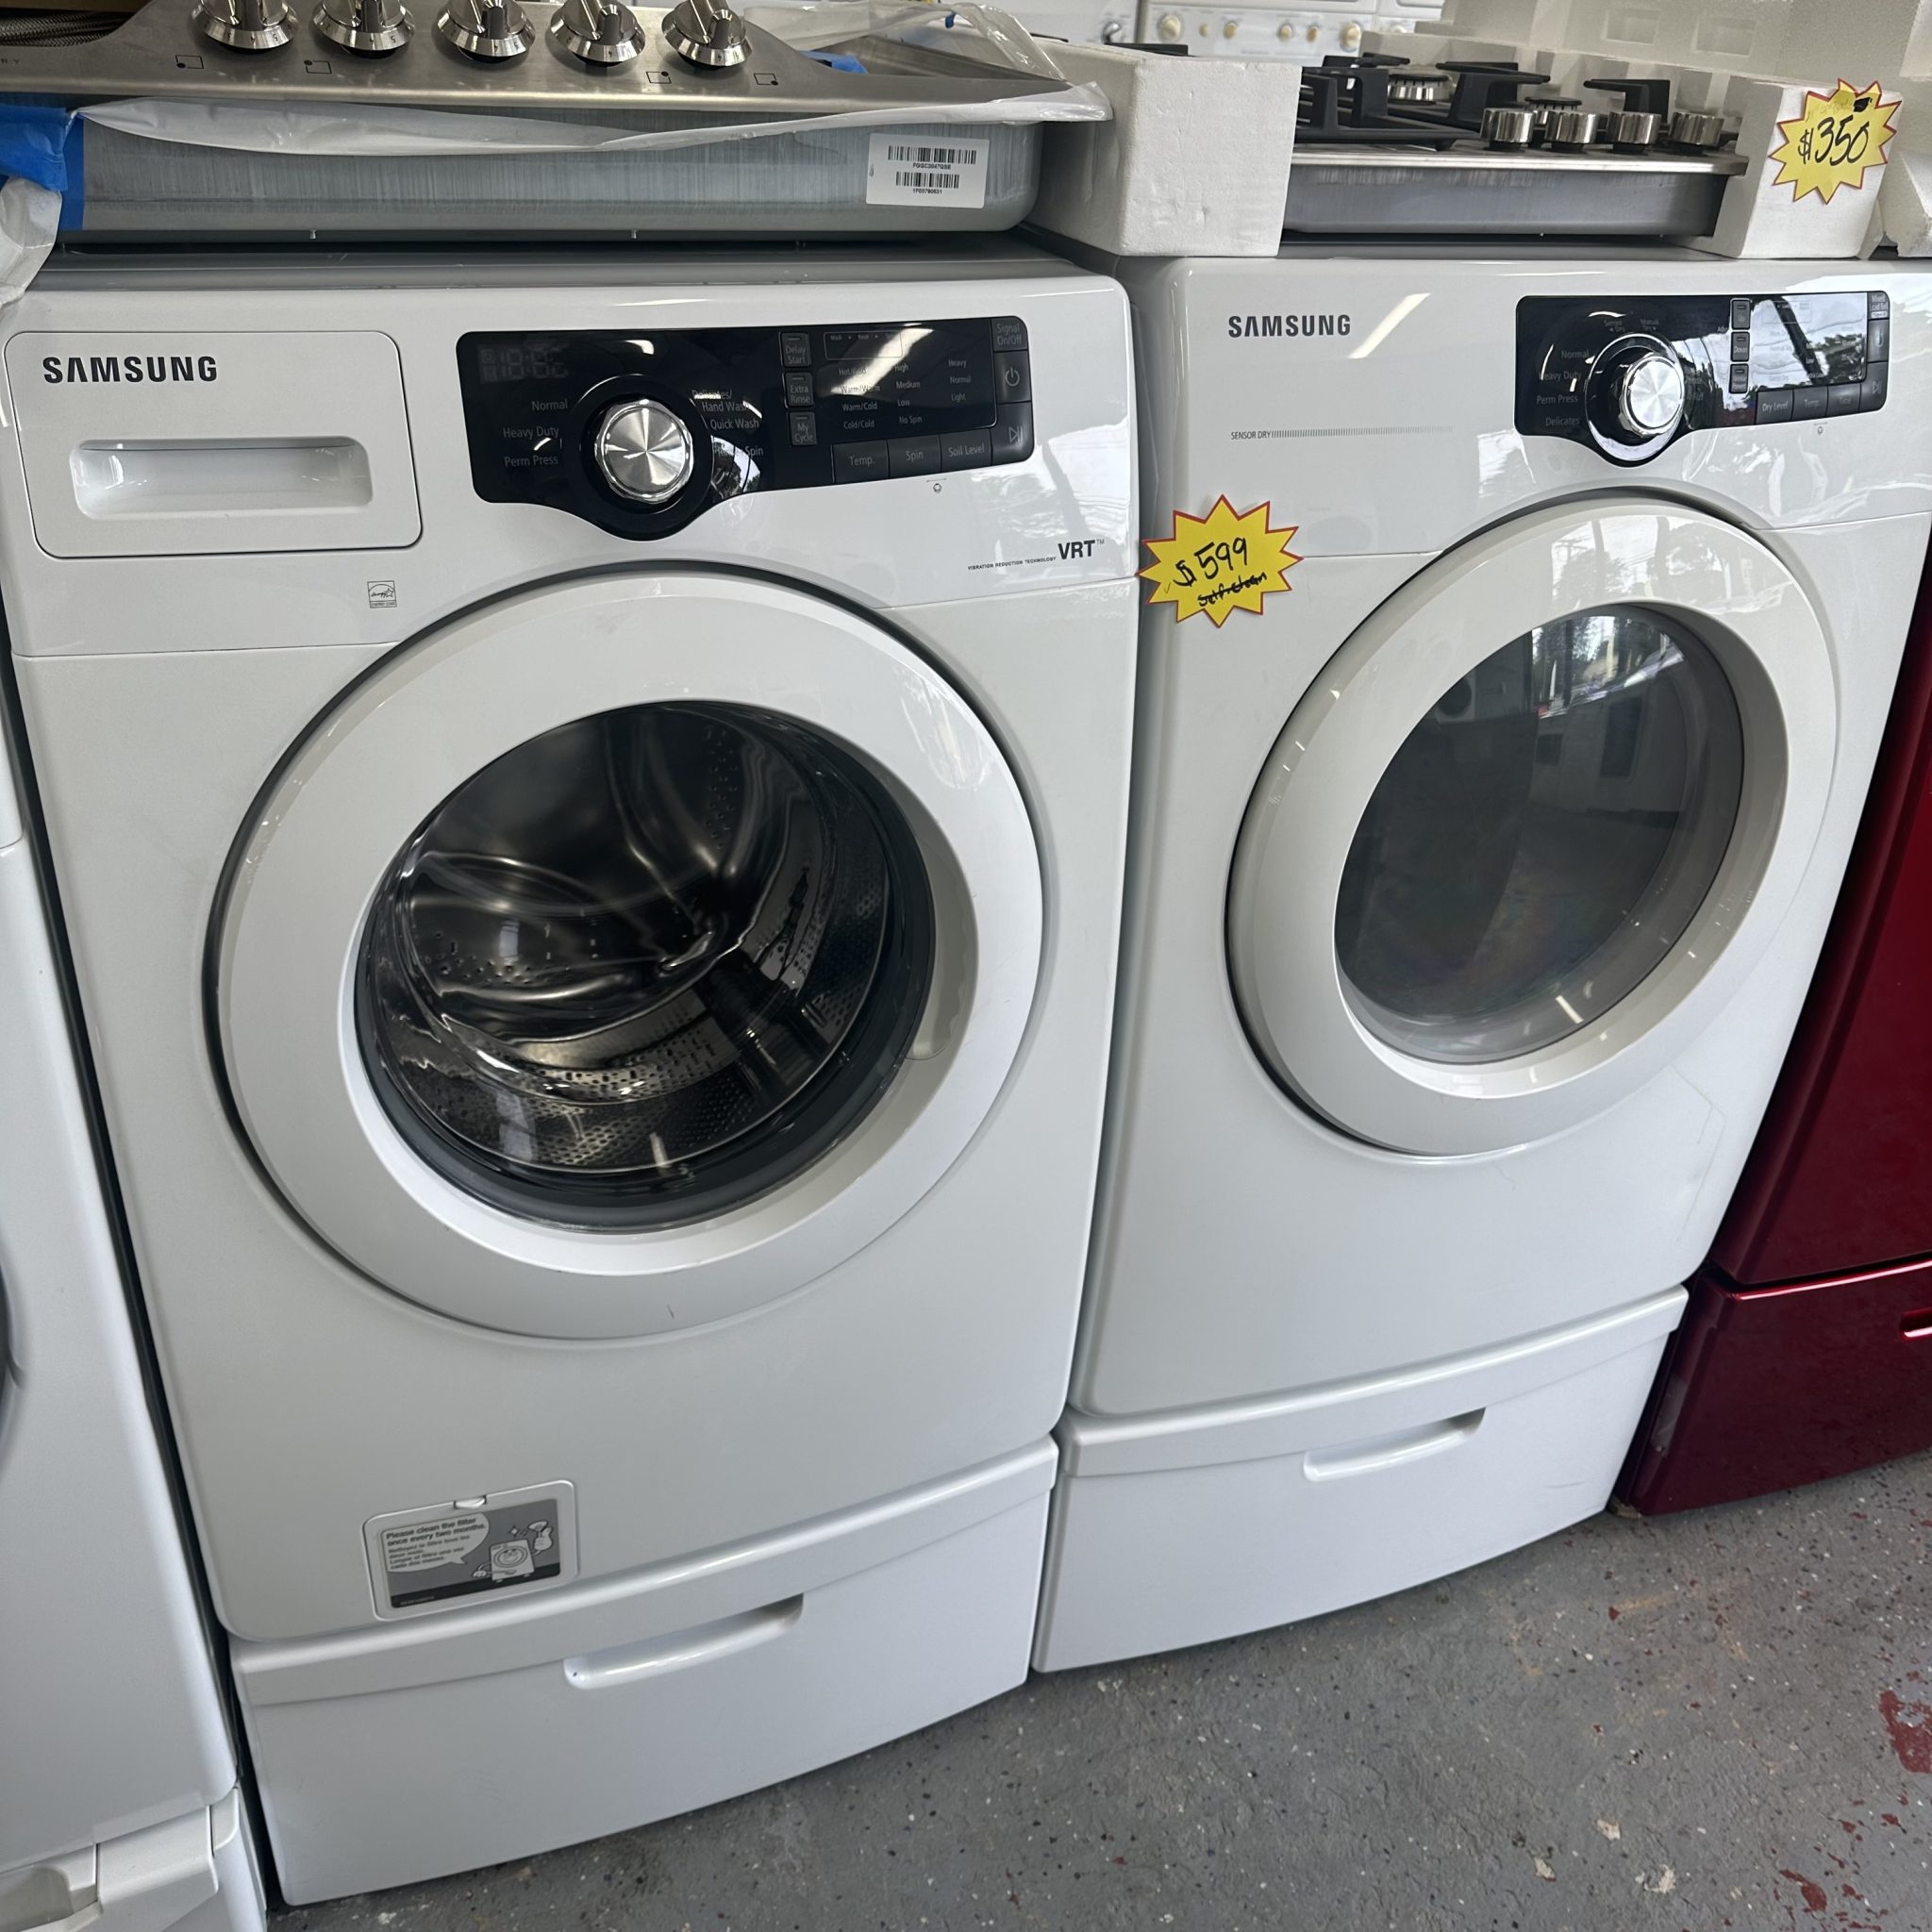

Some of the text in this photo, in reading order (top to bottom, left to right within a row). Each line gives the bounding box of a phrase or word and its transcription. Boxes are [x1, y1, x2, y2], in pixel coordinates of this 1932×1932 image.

[1797, 114, 1870, 166] $350
[996, 323, 1021, 334] Signal
[1227, 314, 1351, 338] SAMSUNG
[997, 335, 1023, 346] On/Off
[785, 345, 807, 356] Delay
[1560, 348, 1591, 359] Normal
[1733, 345, 1748, 355] Down
[788, 355, 806, 365] Start
[948, 358, 967, 369] Heavy
[42, 355, 217, 384] SAMSUNG
[894, 362, 909, 374] High
[950, 375, 972, 384] Normal
[1563, 370, 1582, 381] Duty
[790, 384, 809, 394] Extra
[895, 380, 921, 390] Medium
[791, 393, 810, 404] Rinse
[897, 399, 911, 408] Low
[951, 392, 967, 404] Light
[1536, 394, 1578, 405] Perm Press
[531, 398, 568, 411] Normal
[702, 401, 724, 412] Hand
[841, 401, 878, 412] Warm/Cold
[1761, 401, 1789, 413] Dry Level
[709, 418, 759, 430] Quick Wash
[842, 419, 875, 429] Cold/Cold
[898, 415, 924, 425] No Spin
[1545, 416, 1580, 426] Delicates
[503, 425, 559, 440] Heavy Duty
[1230, 430, 1271, 440] SENSOR DRY
[793, 433, 814, 444] Cycle
[744, 445, 764, 458] Spin
[906, 450, 924, 462] Spin
[947, 443, 985, 458] Soil Level
[504, 455, 559, 468] Perm Press
[848, 456, 876, 467] Temp.
[967, 562, 994, 571] VIBRATION
[994, 559, 1024, 568] REDUCTION
[1058, 540, 1095, 560] VRT
[1173, 537, 1248, 587] $599
[387, 1529, 415, 1540] Please
[416, 1525, 440, 1535] clean
[457, 1518, 476, 1526] filter
[388, 1538, 408, 1547] once
[409, 1533, 434, 1542] every
